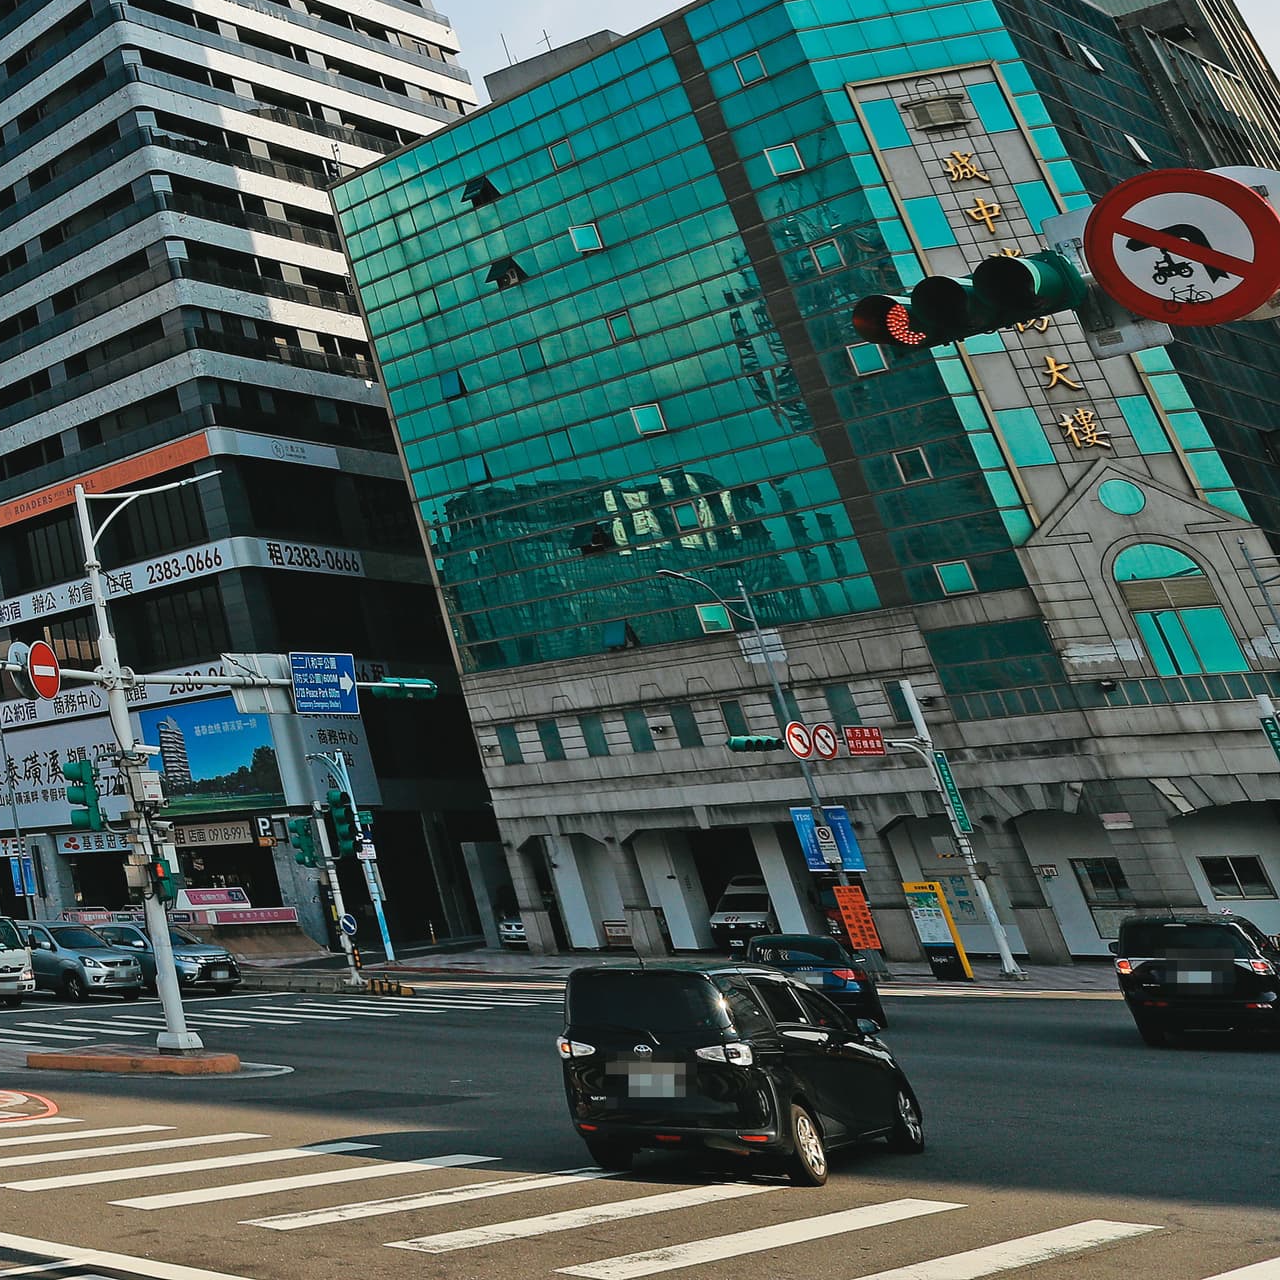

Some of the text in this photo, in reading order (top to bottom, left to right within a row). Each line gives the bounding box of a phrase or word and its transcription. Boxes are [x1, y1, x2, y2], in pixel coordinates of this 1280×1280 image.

[14, 493, 53, 515] ROADERS
[66, 479, 97, 497] HEL
[146, 547, 223, 585] 2383-0666
[53, 690, 102, 716] 商務中心
[316, 728, 359, 746] 商務中心
